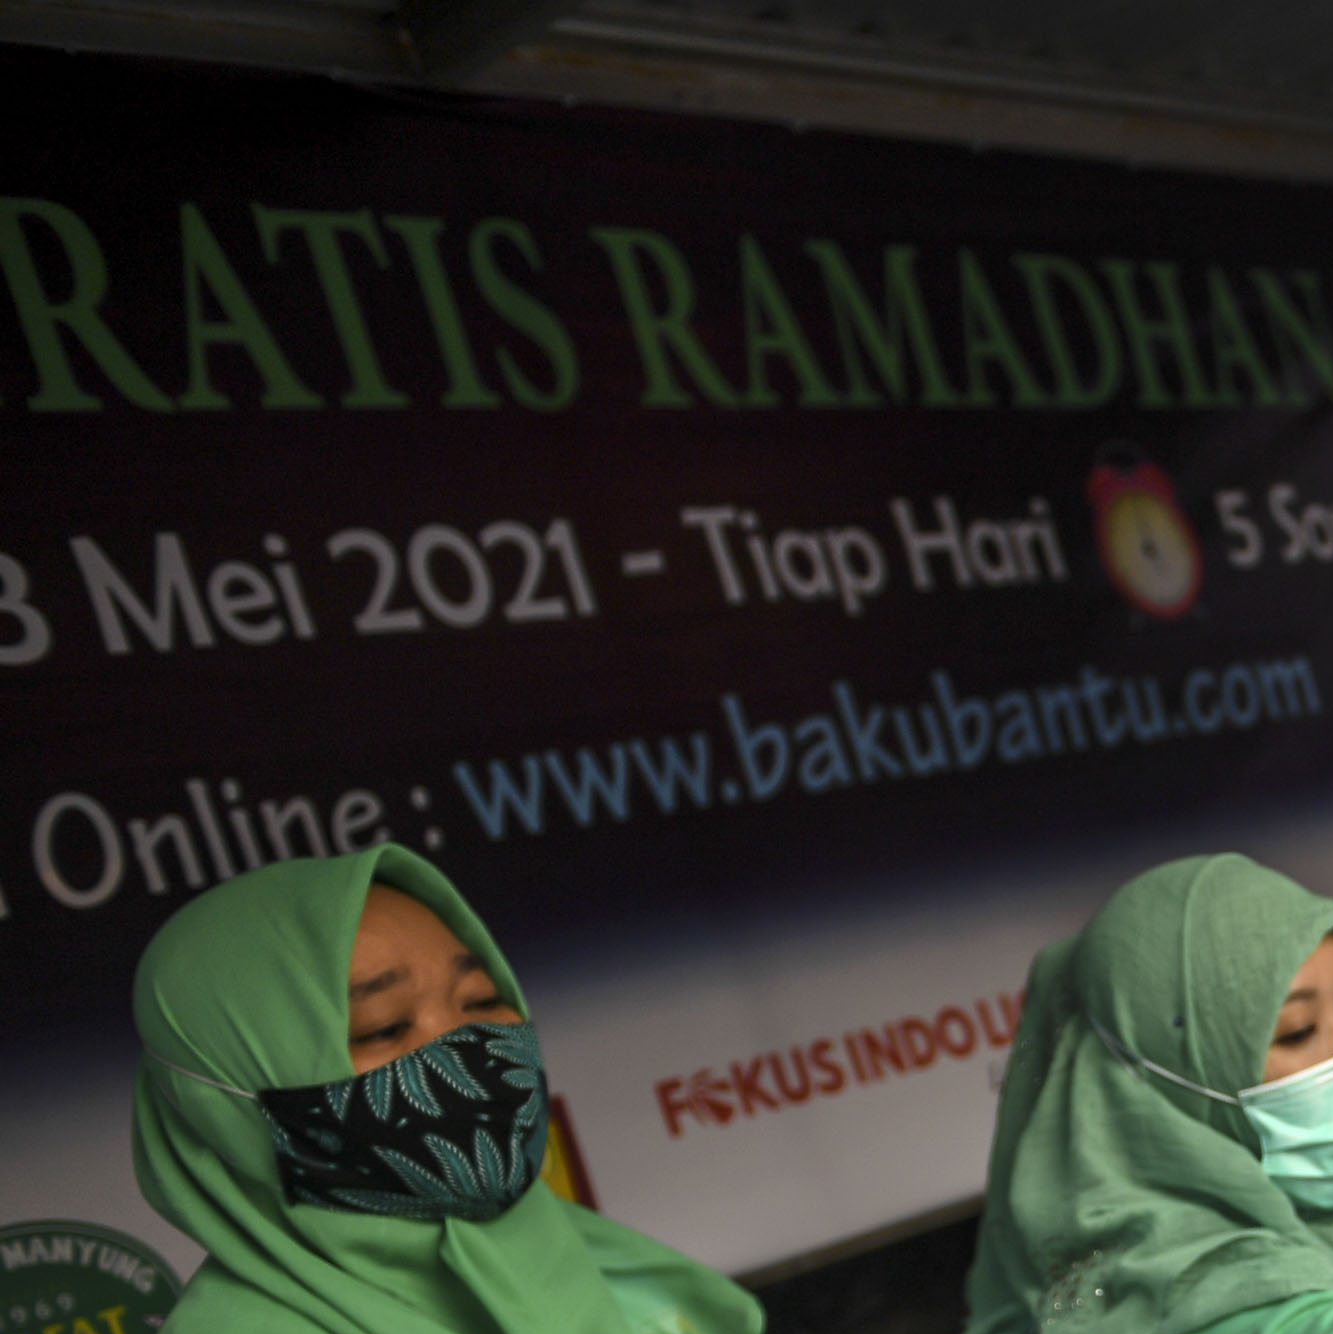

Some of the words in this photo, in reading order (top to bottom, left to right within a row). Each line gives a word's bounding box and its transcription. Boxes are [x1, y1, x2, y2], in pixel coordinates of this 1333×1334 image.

[0, 197, 581, 413] RATIS
[68, 530, 317, 656] Mei
[327, 516, 599, 635] 2021
[681, 505, 887, 617] Tiap
[890, 494, 1069, 592] Hari
[1212, 488, 1263, 569] 5
[31, 777, 393, 909] Online
[453, 654, 1325, 841] www.bakubantu.com
